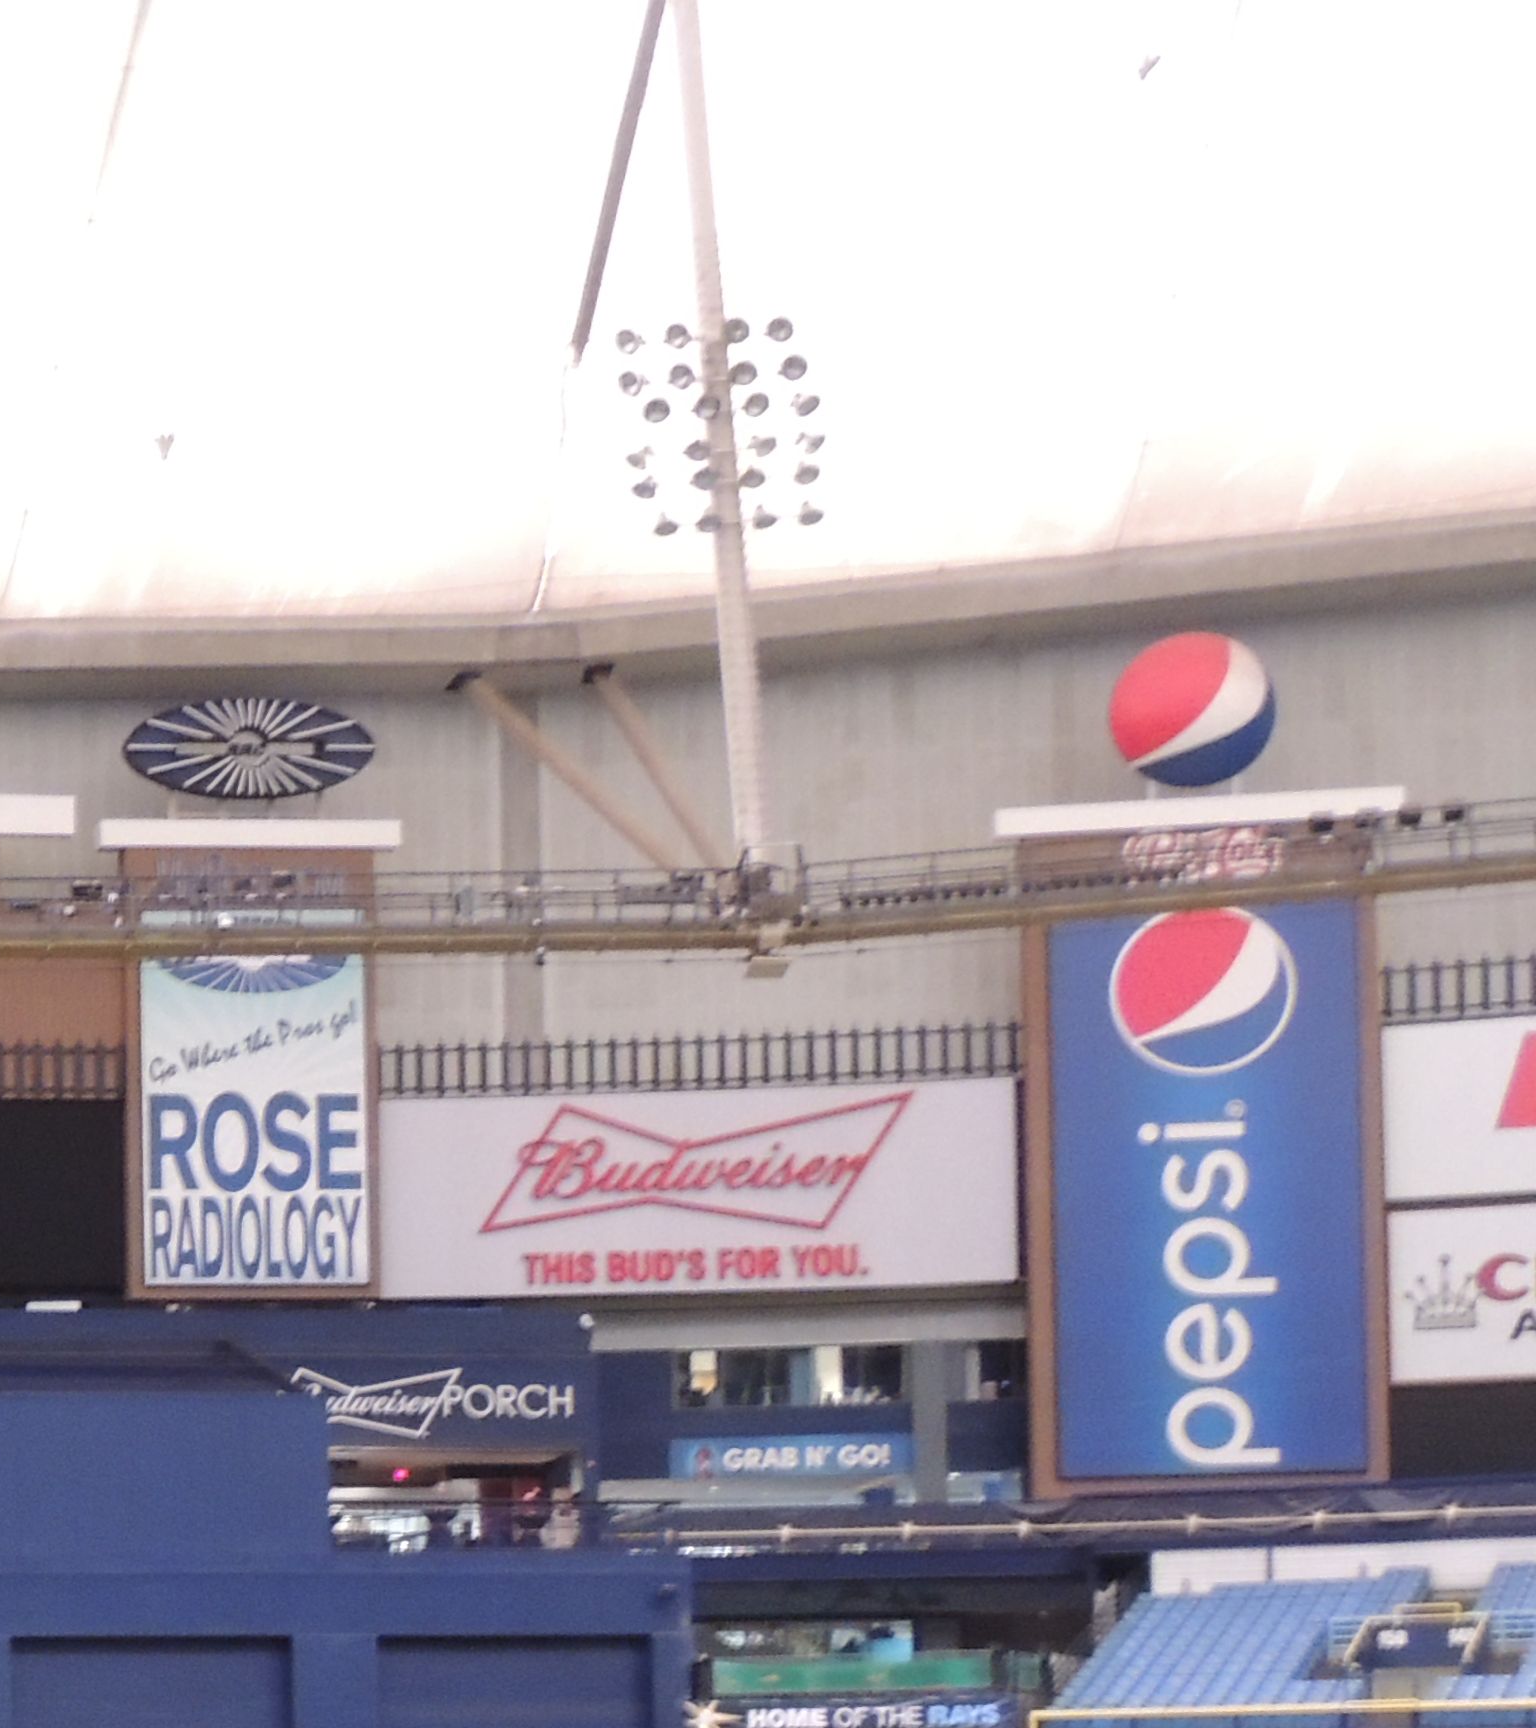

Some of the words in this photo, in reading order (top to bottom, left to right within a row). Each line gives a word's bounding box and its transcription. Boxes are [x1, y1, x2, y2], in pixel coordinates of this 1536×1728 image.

[180, 1040, 240, 1072] Where
[244, 1025, 273, 1054] the
[148, 1092, 363, 1192] ROSE
[518, 1135, 873, 1201] Budweiser
[149, 1195, 362, 1280] RADIOLOGY
[522, 1249, 597, 1285] THIS
[607, 1246, 706, 1283] BUD'S
[717, 1245, 782, 1280] FOR
[790, 1243, 870, 1278] YOU.
[1137, 1119, 1282, 1467] pepsi
[440, 1383, 576, 1420] PORCH
[722, 1446, 800, 1472] GRAB
[837, 1442, 892, 1468] GO!
[927, 1702, 1002, 1728] RAYS
